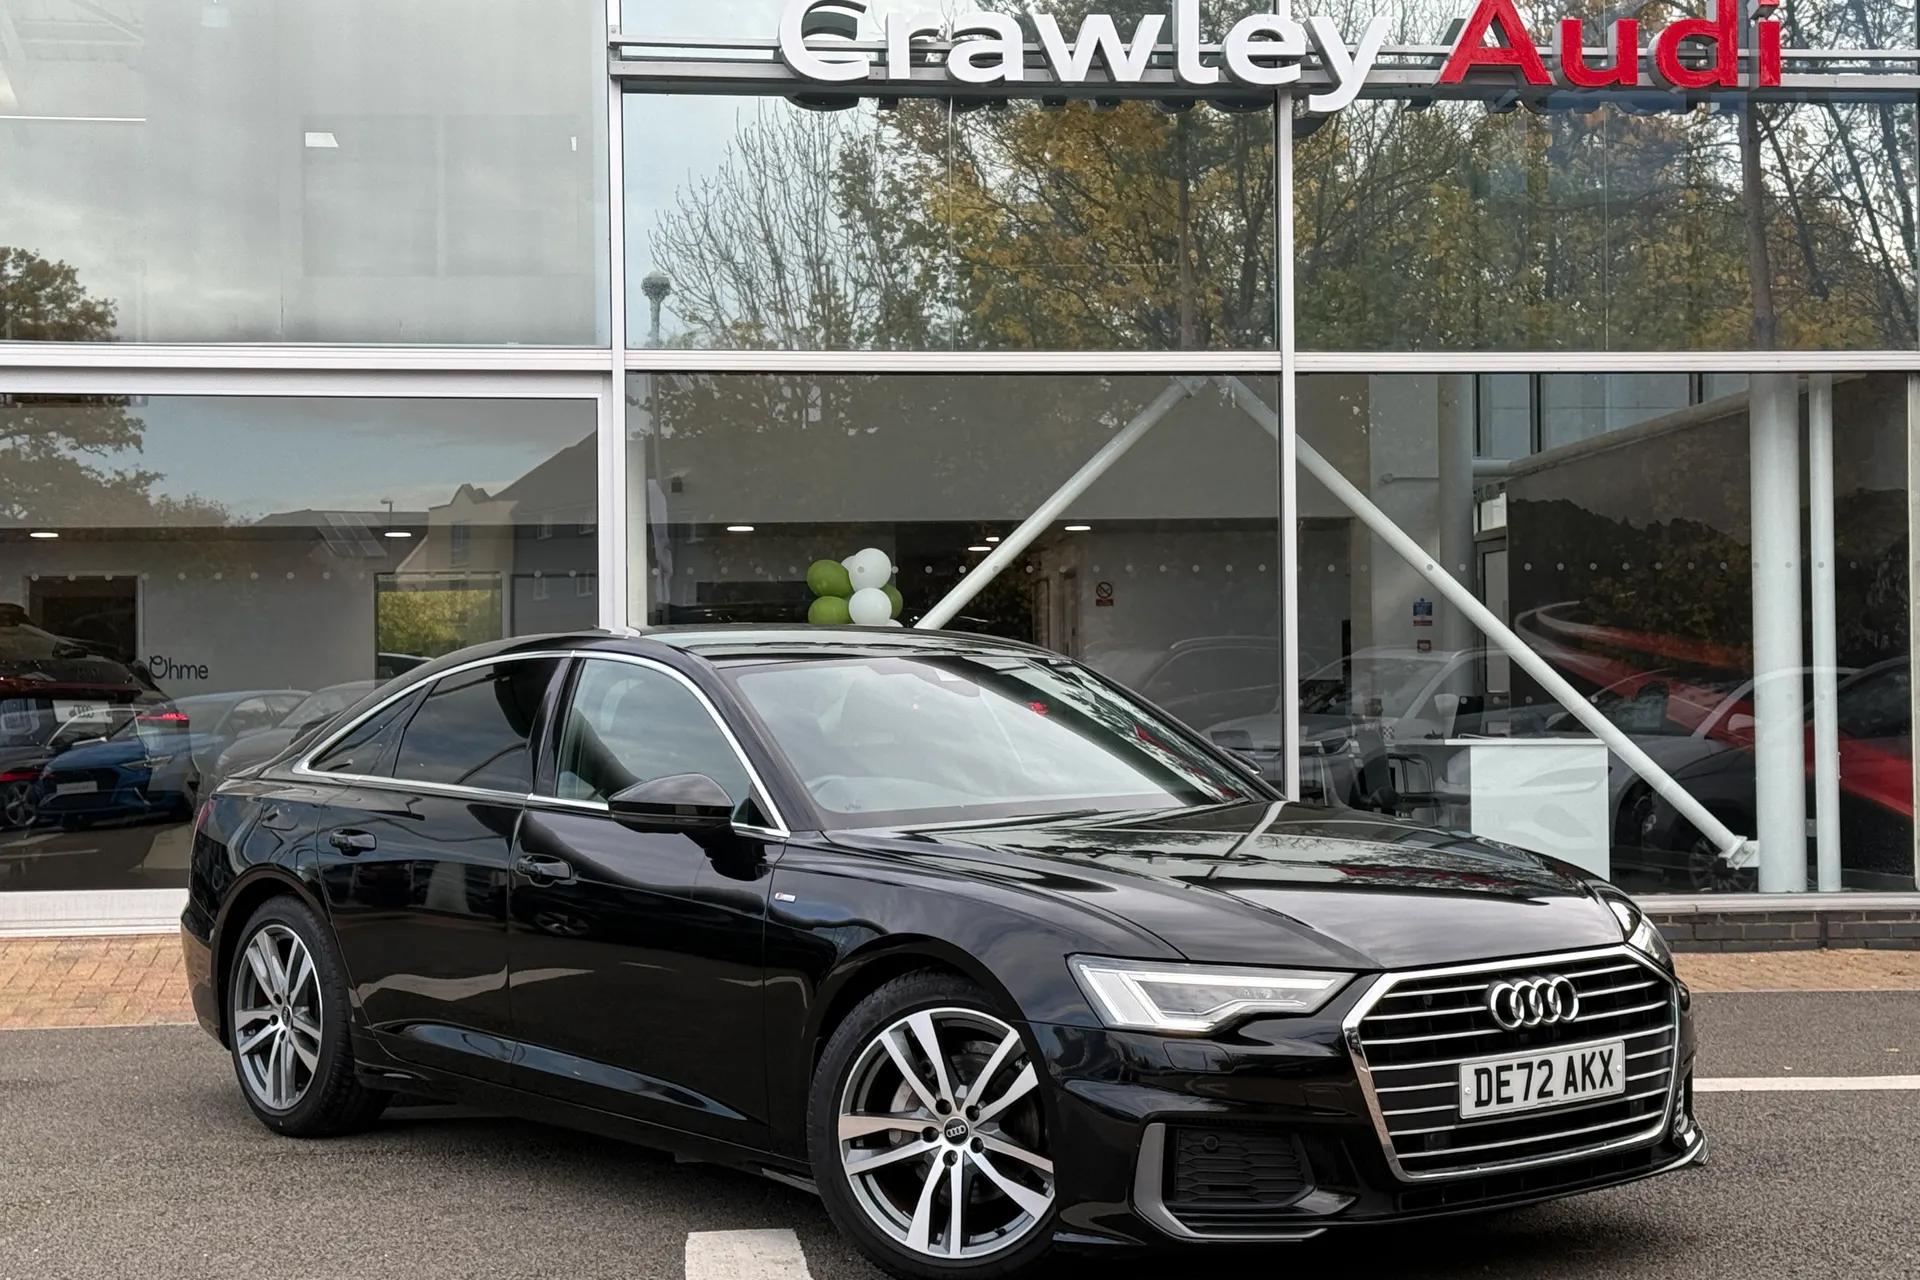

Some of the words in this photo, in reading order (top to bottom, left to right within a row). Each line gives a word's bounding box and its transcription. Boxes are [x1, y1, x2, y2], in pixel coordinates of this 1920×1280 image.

[779, 0, 1394, 113] Crawley
[1439, 0, 1782, 88] Audi
[149, 655, 209, 680] Ohme
[1474, 1059, 1554, 1108] DE72
[1563, 1049, 1614, 1096] AKX
